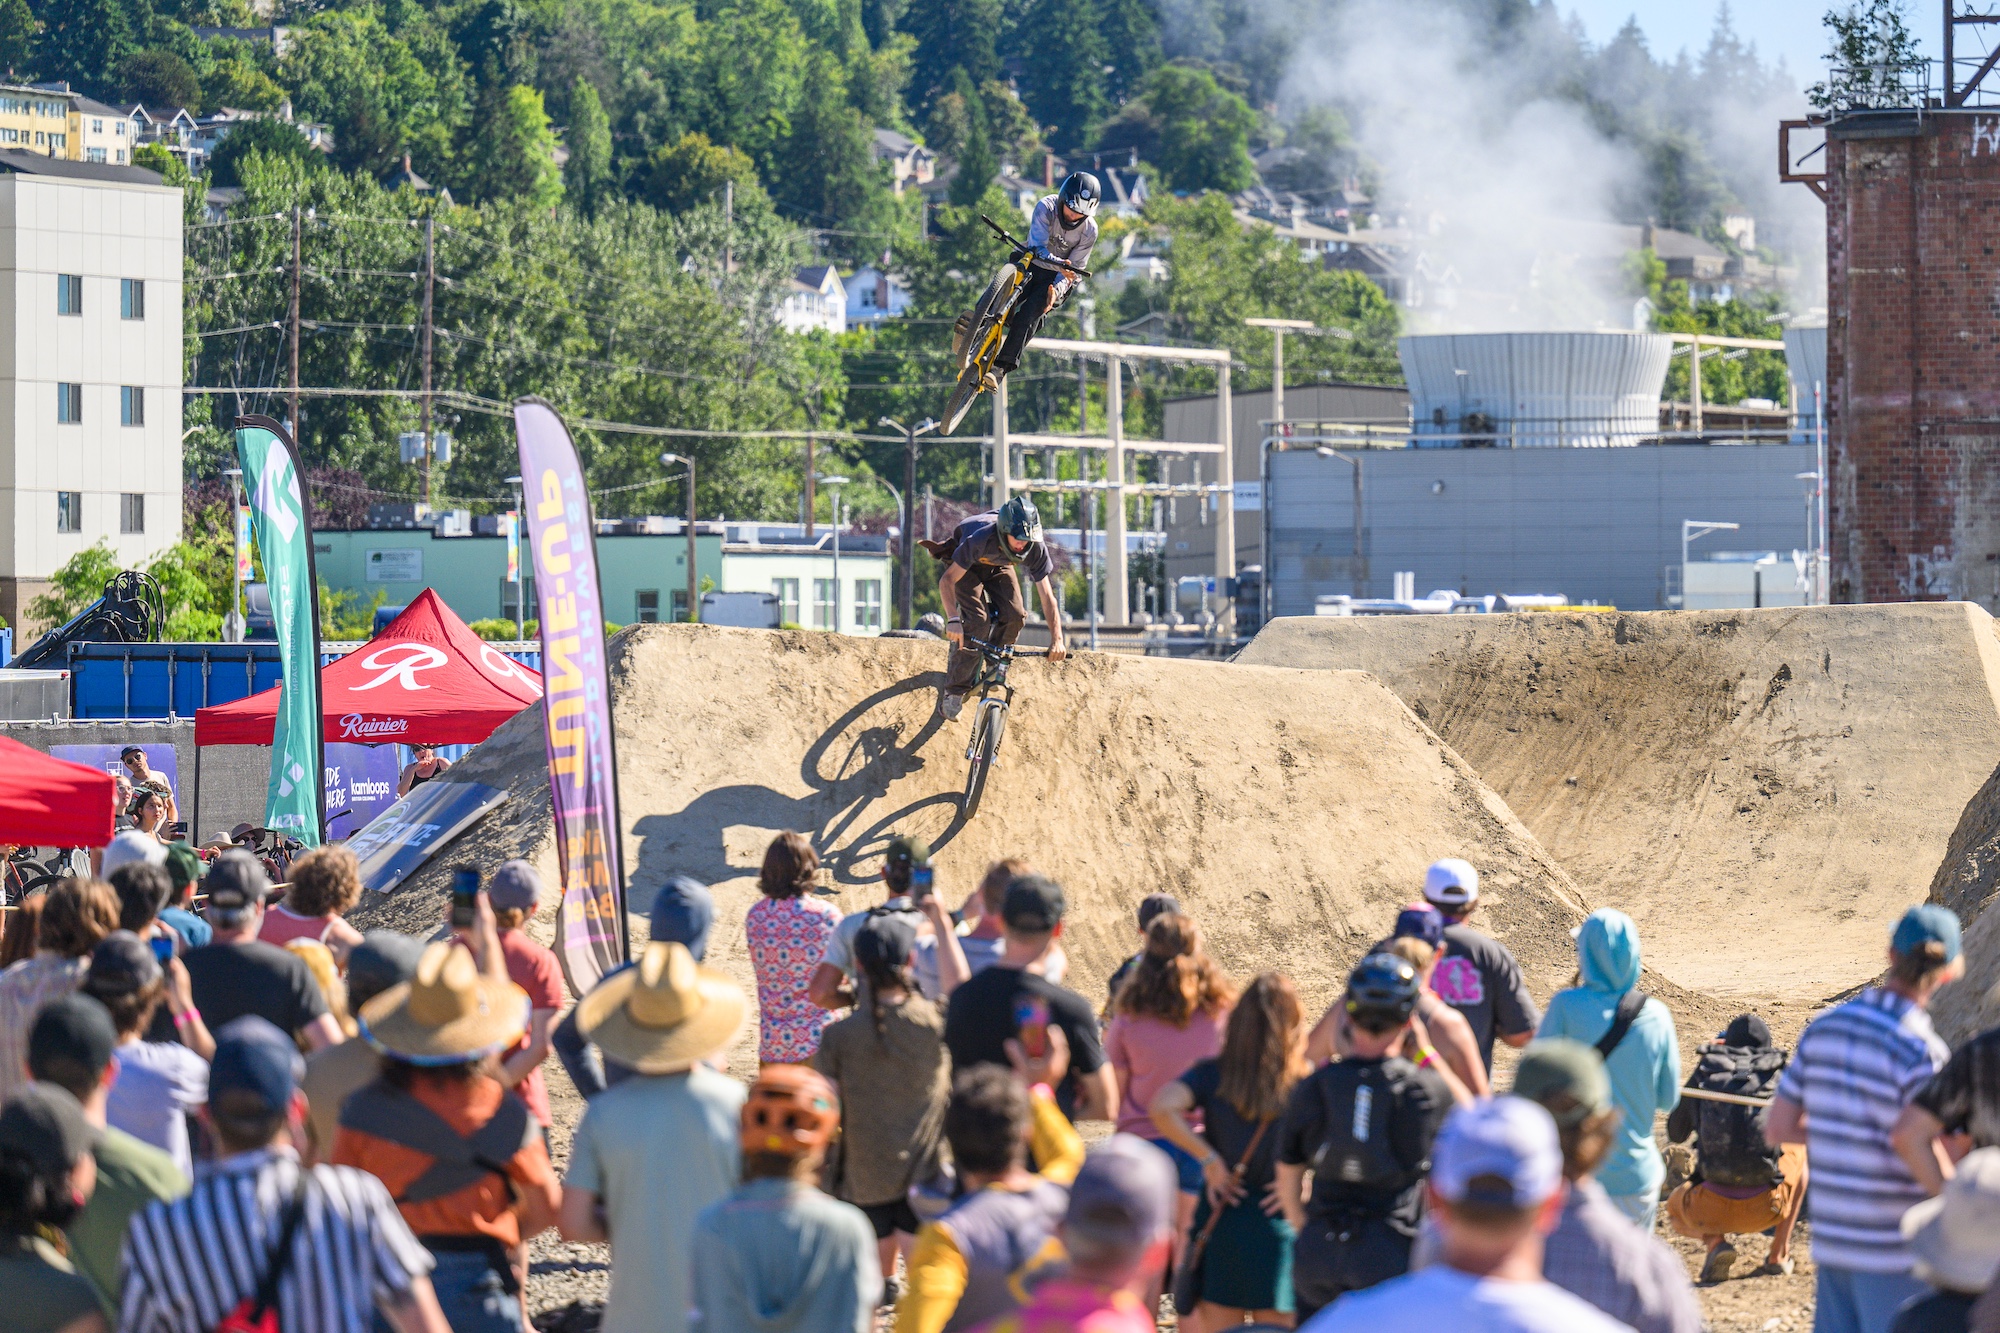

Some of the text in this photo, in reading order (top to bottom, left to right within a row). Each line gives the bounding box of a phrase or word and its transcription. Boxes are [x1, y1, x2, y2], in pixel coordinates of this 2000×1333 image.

[291, 661, 299, 695] IMPACT
[348, 643, 449, 691] R
[339, 713, 408, 738] Rainier
[324, 766, 340, 788] IDE
[350, 777, 390, 800] kamloops
[325, 788, 347, 811] HERE
